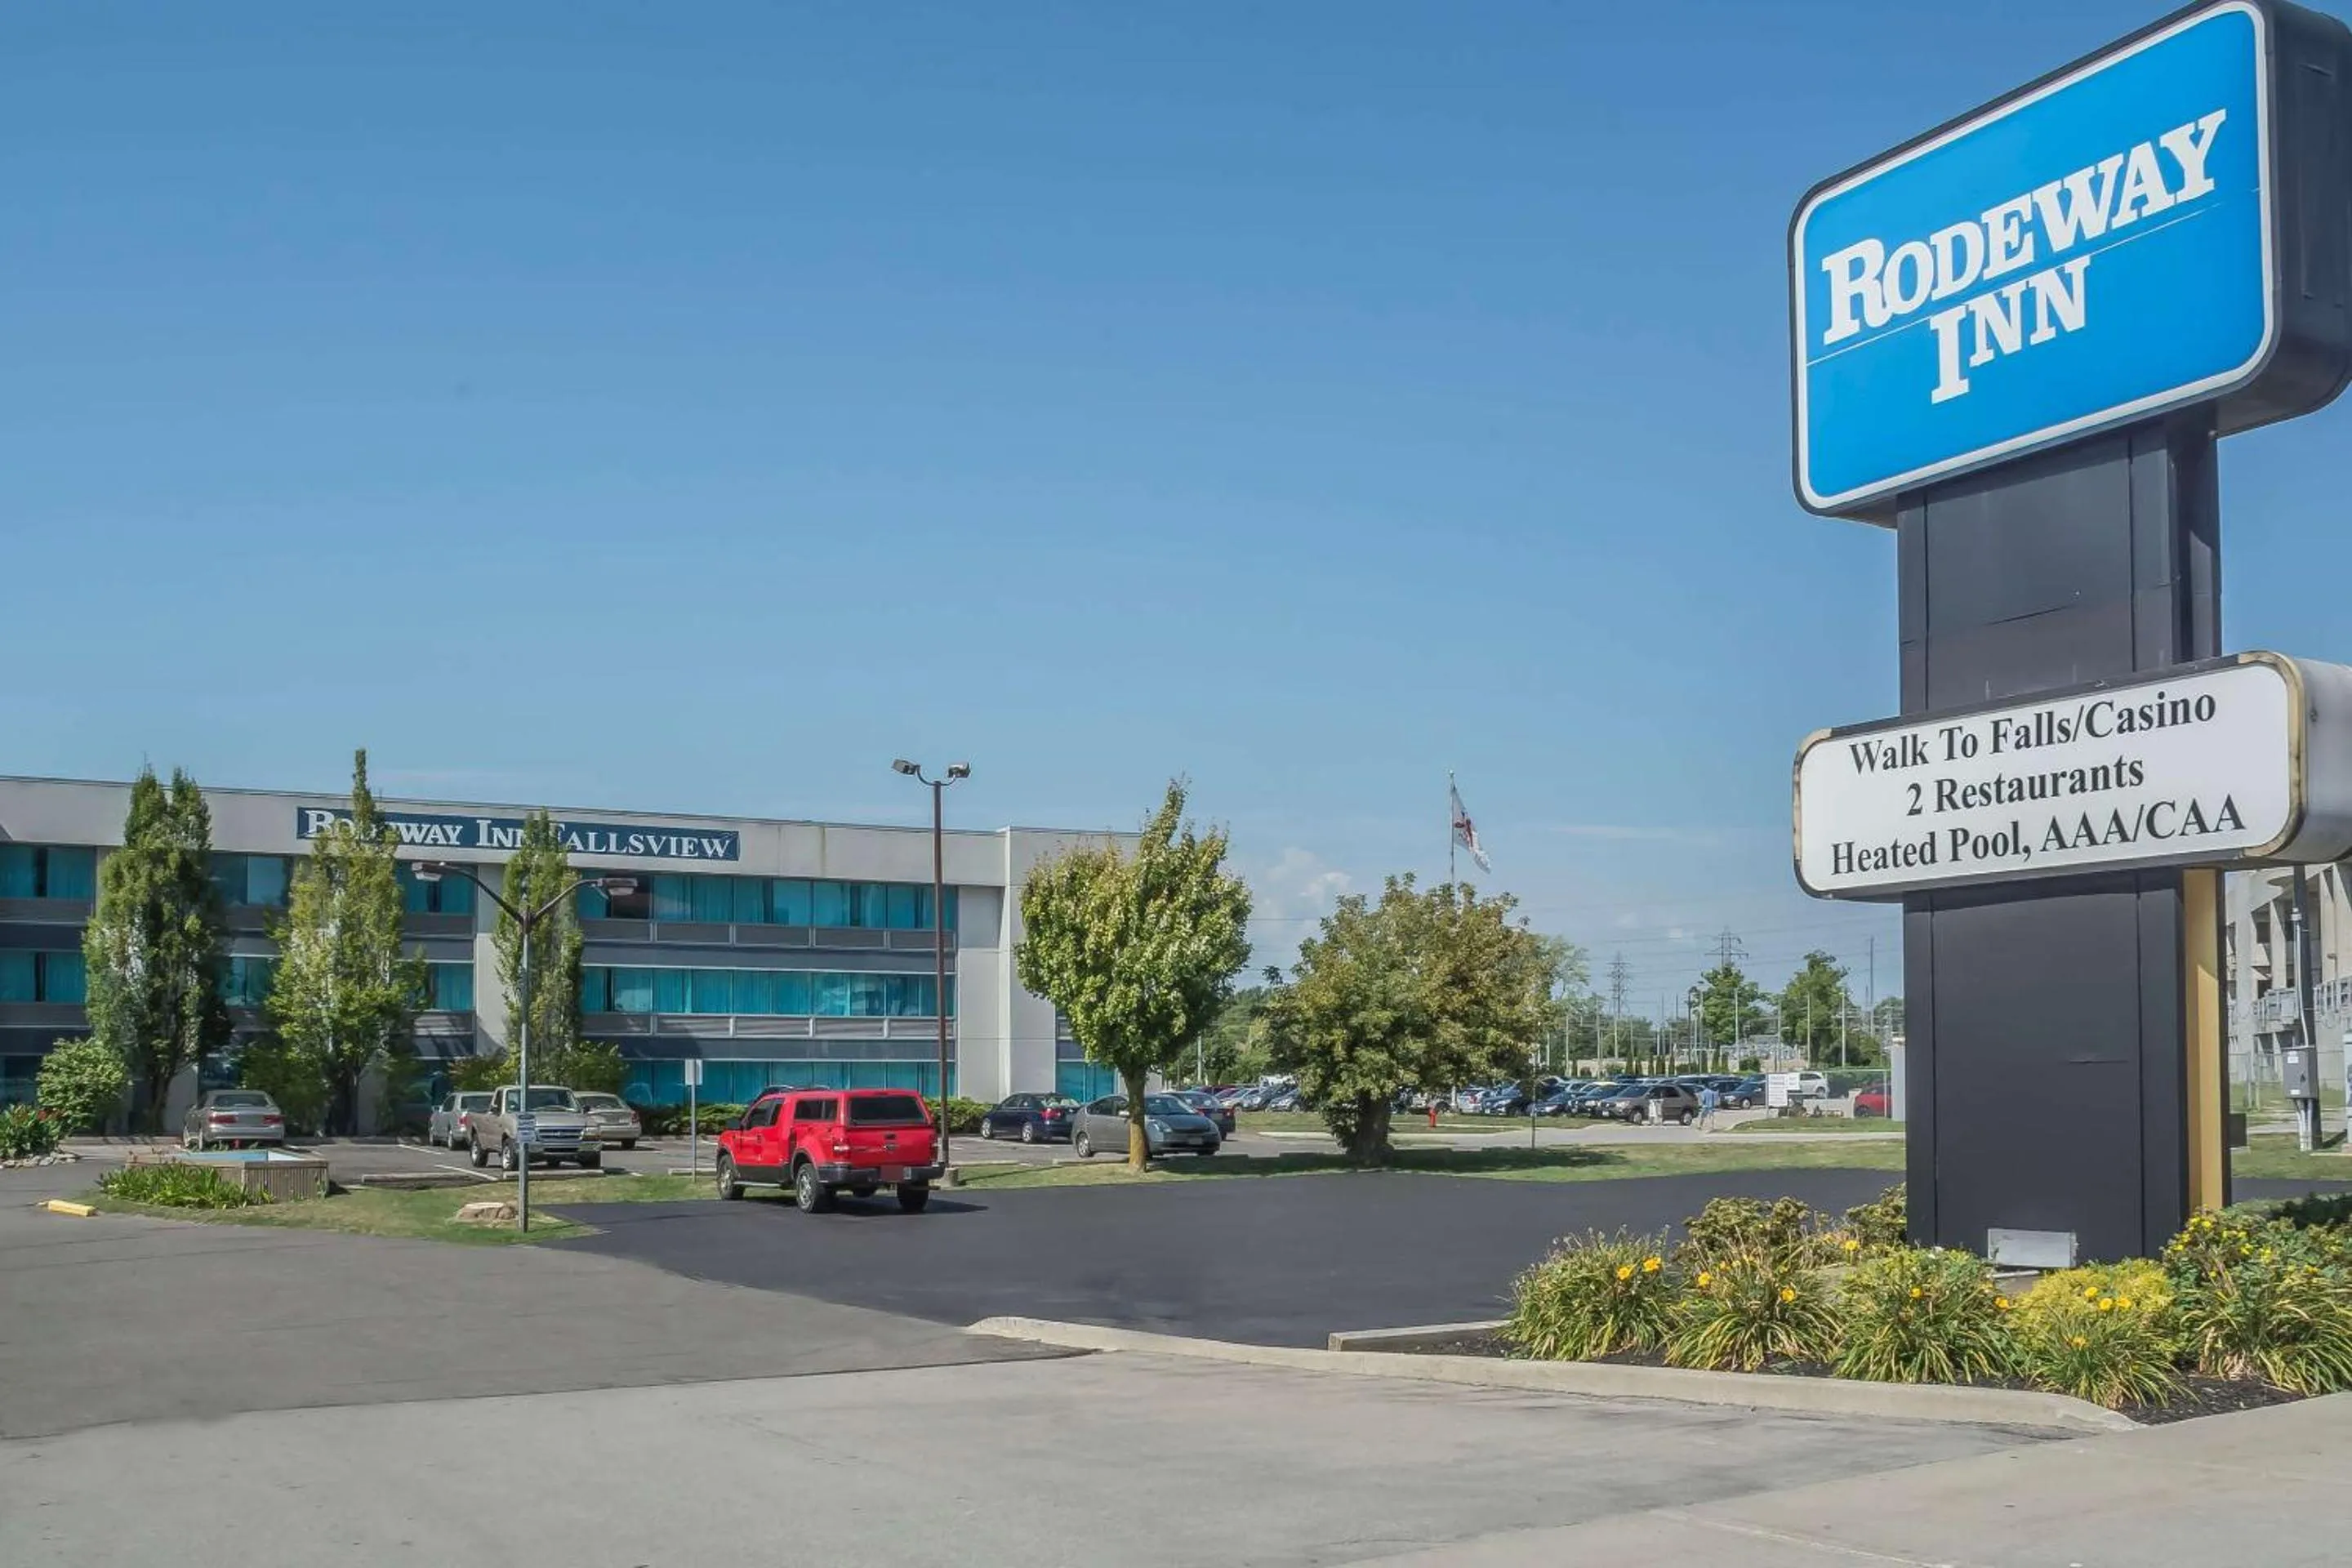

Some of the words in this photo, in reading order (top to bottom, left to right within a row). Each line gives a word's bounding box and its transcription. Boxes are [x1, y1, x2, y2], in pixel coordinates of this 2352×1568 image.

[1821, 108, 2227, 346] RODEWAY
[1929, 254, 2091, 404] INN
[1848, 733, 1930, 775] Walk
[1939, 724, 1979, 761] To
[1989, 691, 2216, 755] Falls/Casino
[1905, 782, 1923, 816] 2
[1934, 755, 2145, 813] Restaurants
[1831, 831, 1938, 875] Heated
[1949, 820, 2033, 863] Pool,
[2039, 793, 2247, 853] AAA/CAA
